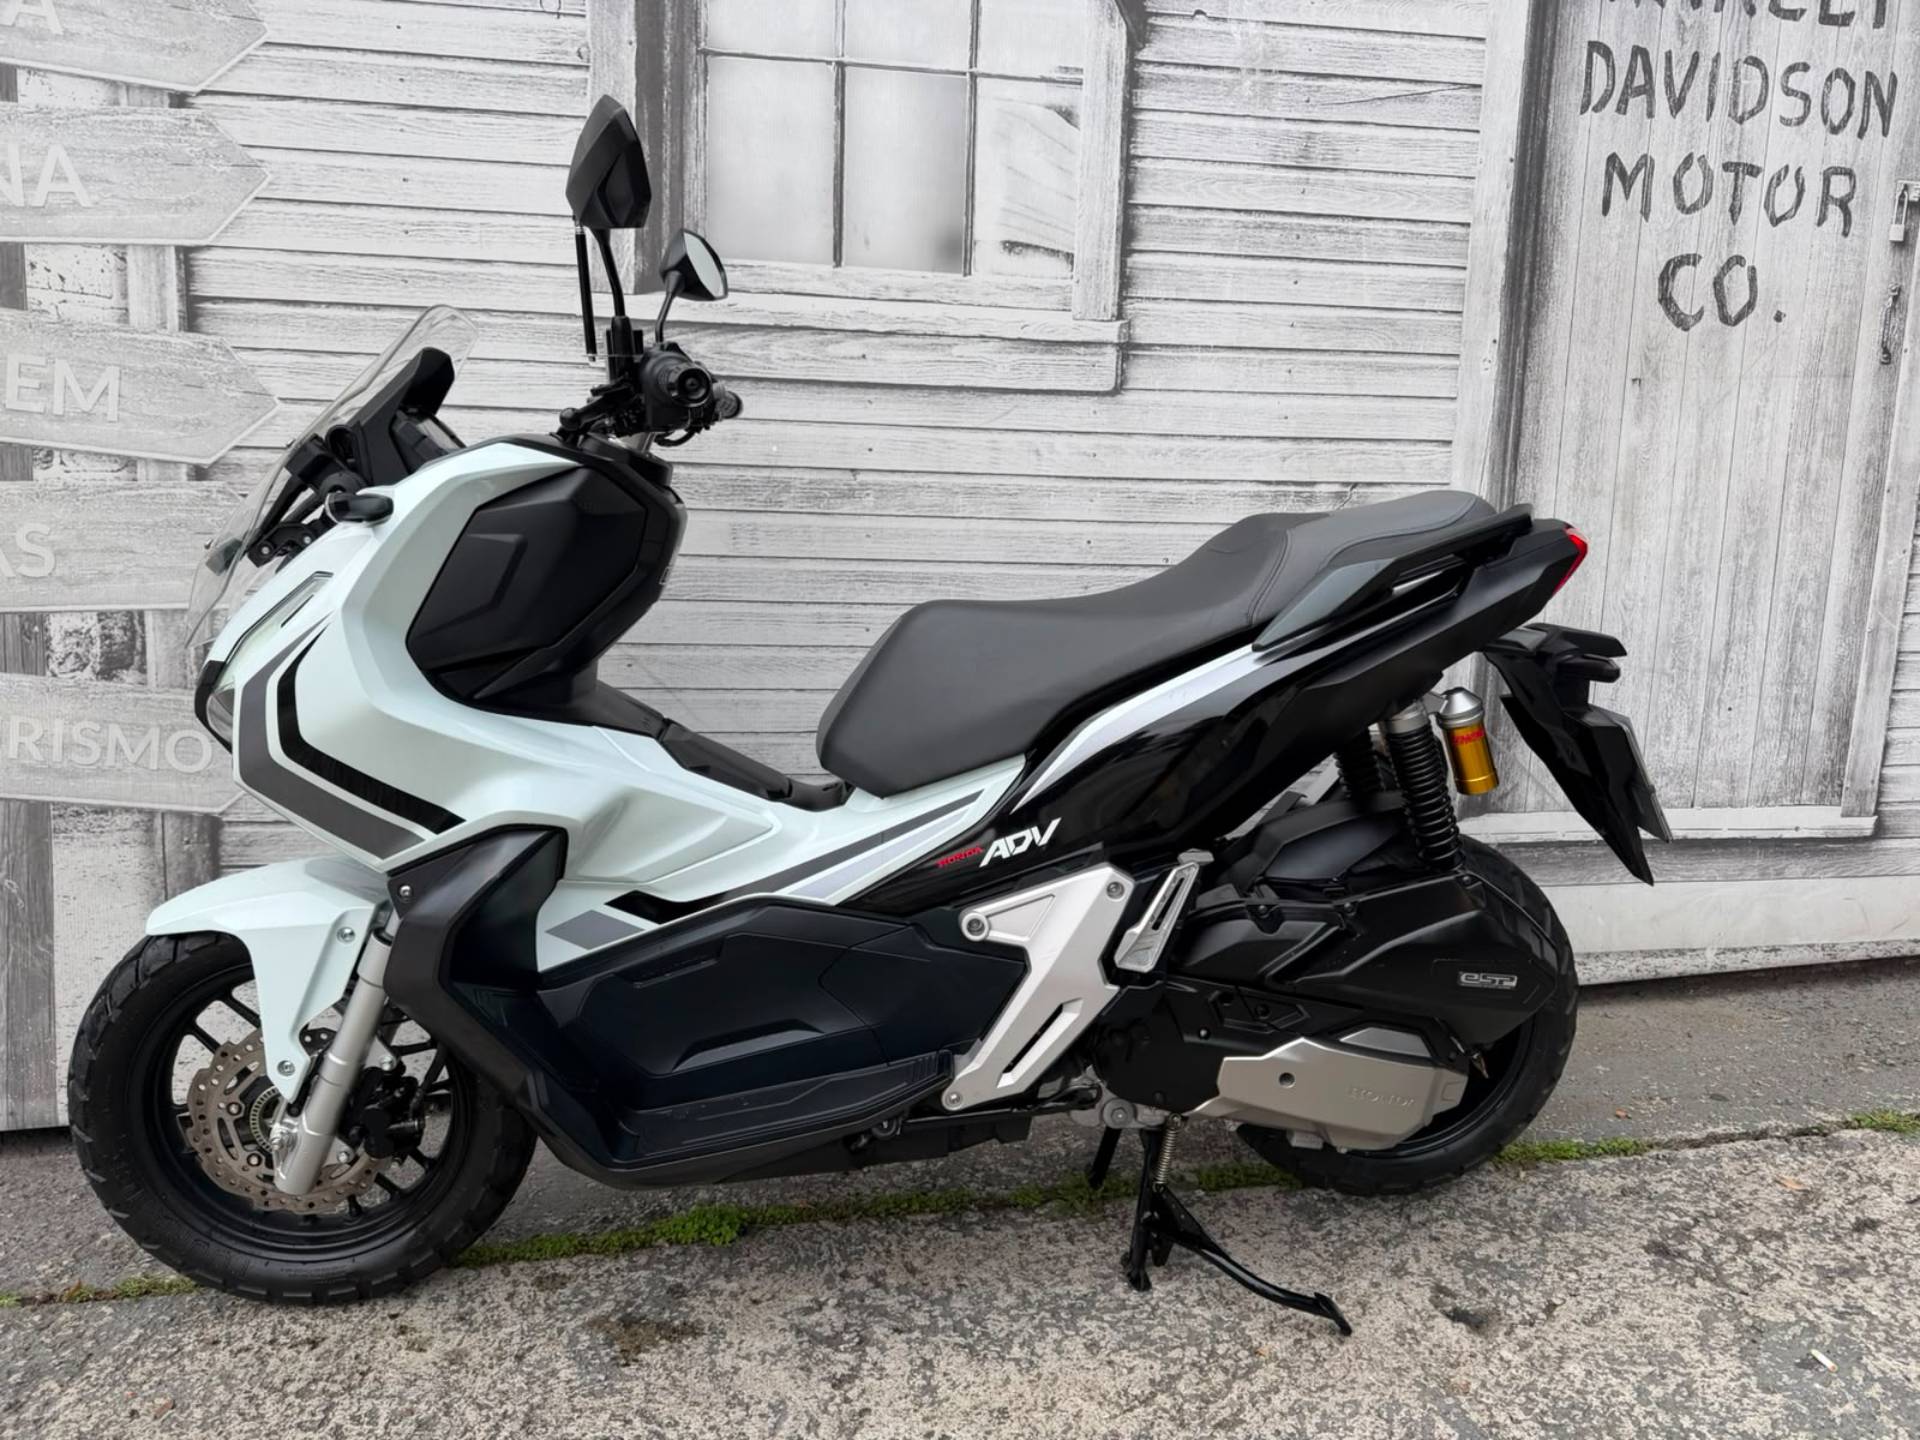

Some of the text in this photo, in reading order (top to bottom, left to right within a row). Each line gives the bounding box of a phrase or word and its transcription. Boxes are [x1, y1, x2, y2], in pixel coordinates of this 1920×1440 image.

[1579, 40, 1898, 139] DAVIDSON
[1602, 152, 1856, 237] MOTOR
[1658, 253, 1786, 331] CO.
[4, 353, 120, 422] EM
[7, 715, 213, 774] RISMO
[979, 817, 1062, 868] ADV
